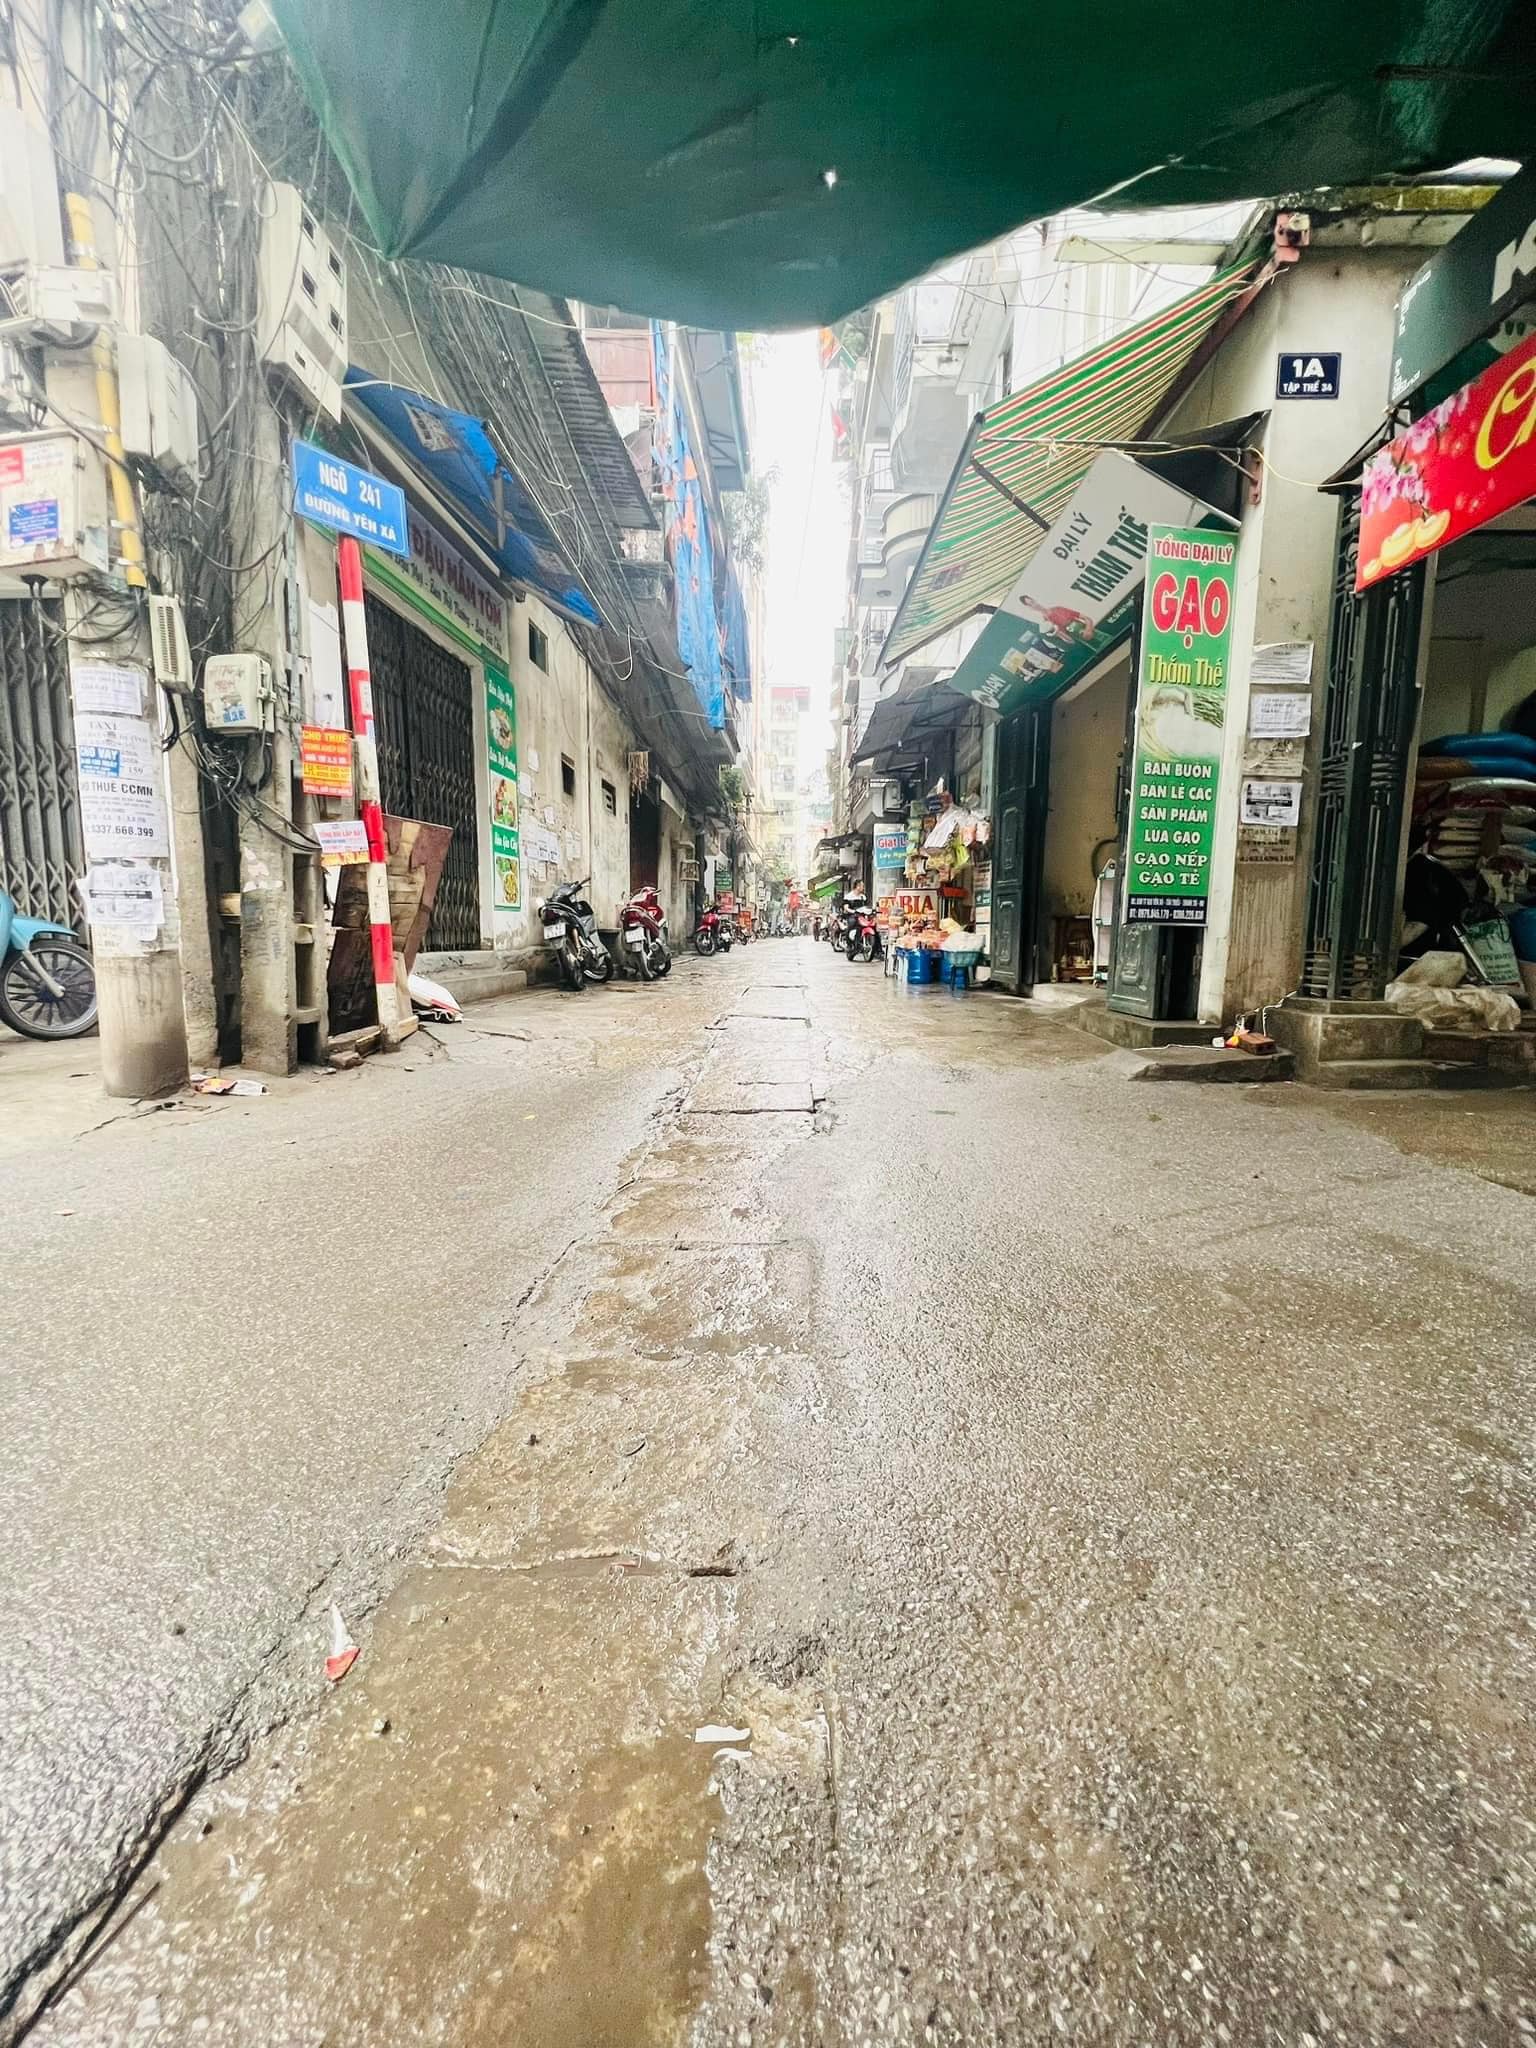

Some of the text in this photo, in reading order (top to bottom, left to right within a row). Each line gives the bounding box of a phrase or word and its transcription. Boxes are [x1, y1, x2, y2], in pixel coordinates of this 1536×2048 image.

[1293, 358, 1325, 378] 1A
[319, 461, 381, 510] NGÕ 241
[304, 492, 350, 522] ĐƯỜNG
[352, 512, 377, 534] YÊN
[1052, 511, 1092, 560] ĐẠI LÝ
[1154, 533, 1235, 566] TỔNG ĐẠI LÝ
[1152, 571, 1230, 649] GẠO
[1195, 657, 1223, 688] Thế
[121, 784, 153, 796] CCMN
[1172, 831, 1201, 847] GẠO
[1134, 850, 1208, 868] GẠO NẾP
[1138, 871, 1175, 887] GẠO
[900, 895, 934, 915] BIA
